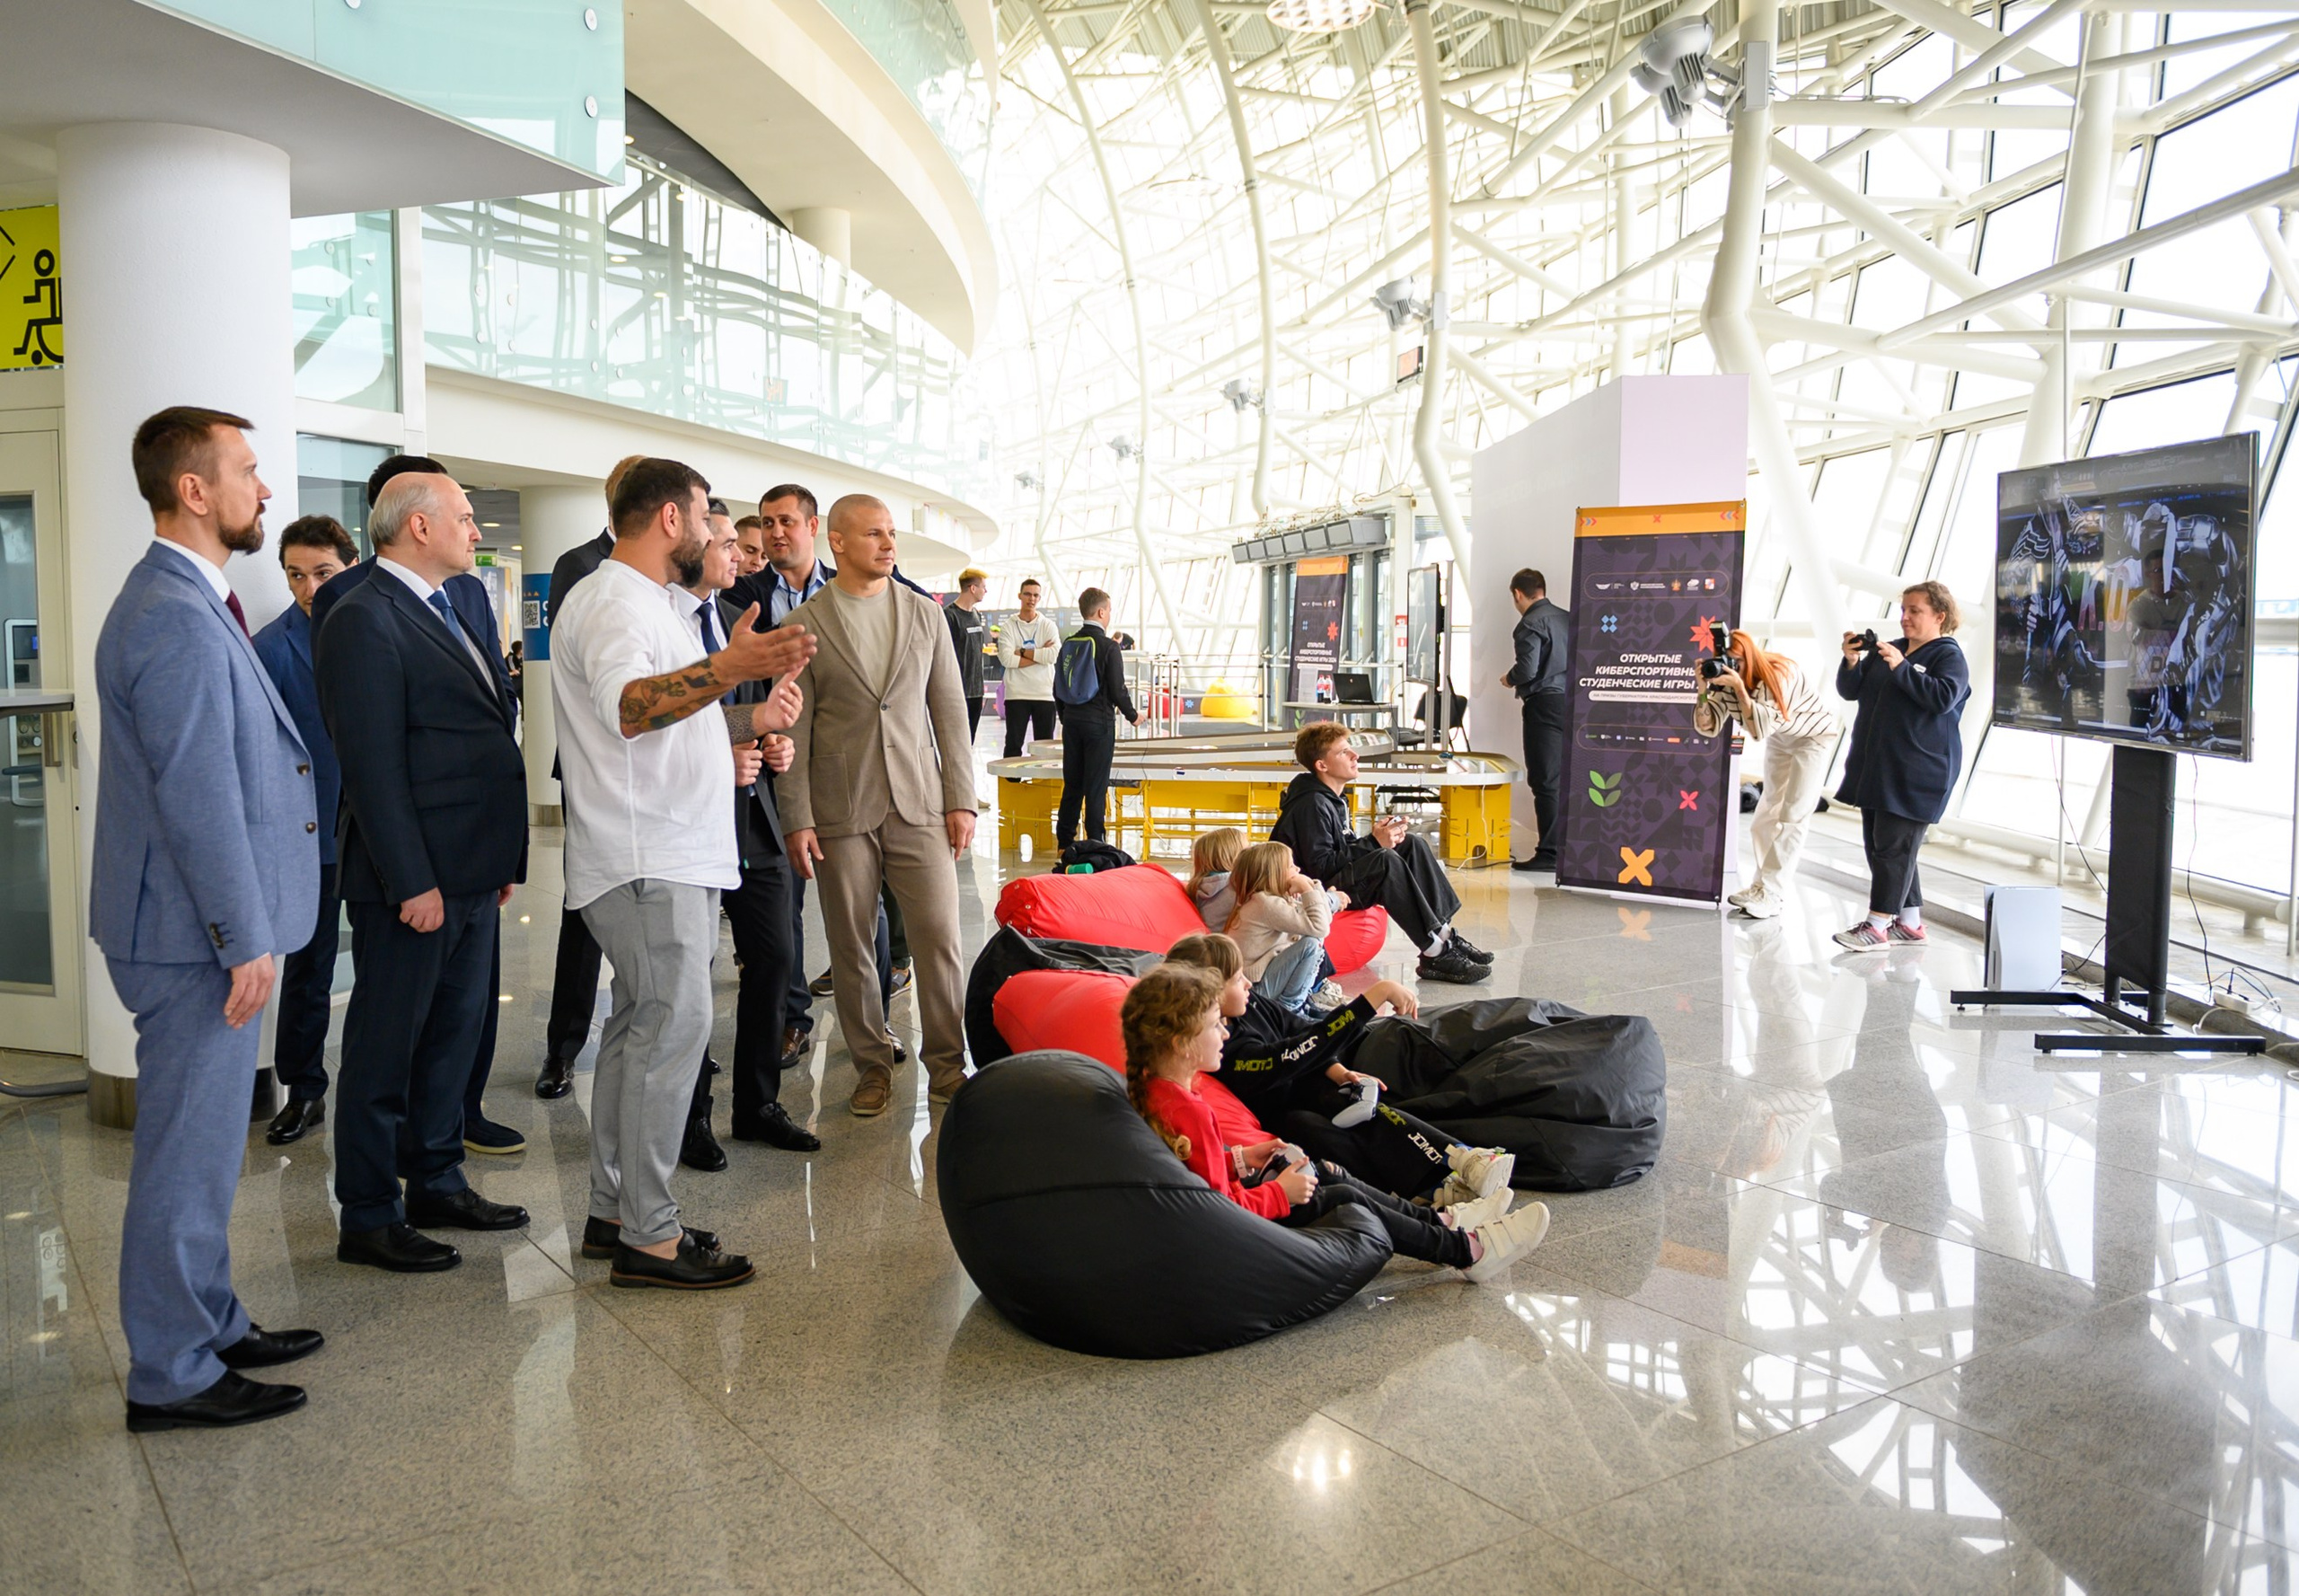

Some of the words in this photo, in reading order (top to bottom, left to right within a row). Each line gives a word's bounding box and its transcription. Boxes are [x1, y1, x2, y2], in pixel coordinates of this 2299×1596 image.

[1619, 653, 1682, 664] ОТКРЫТЫЕ
[1595, 666, 1696, 677] КИБЕРСПОРТИВНЫ
[1579, 677, 1661, 689] СТУДЕНЧЕСКИЕ
[1662, 679, 1696, 690] ИГРЫ
